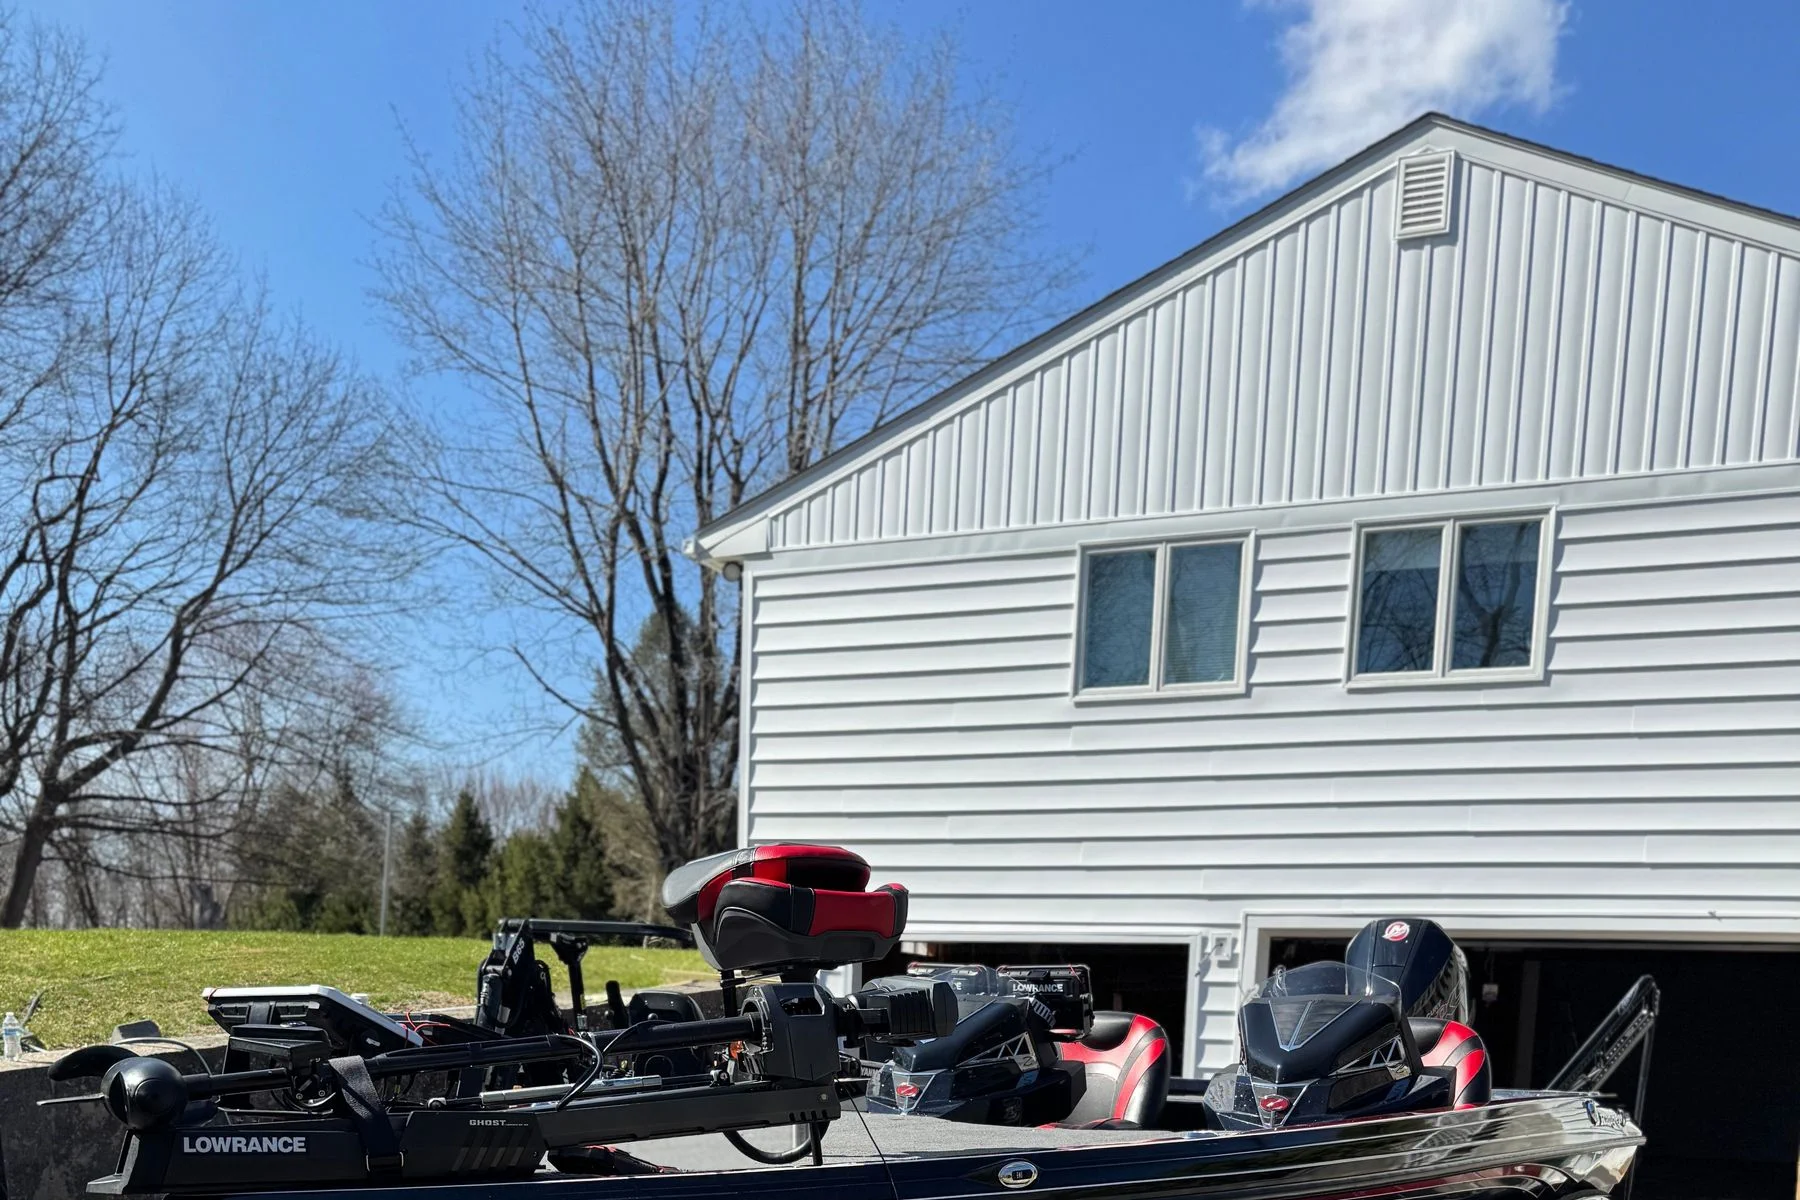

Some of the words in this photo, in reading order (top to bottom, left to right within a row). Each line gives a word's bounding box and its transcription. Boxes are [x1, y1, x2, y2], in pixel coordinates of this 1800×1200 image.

[1012, 983, 1064, 993] LOWRANCE
[469, 1119, 507, 1127] GHOST
[183, 1136, 307, 1153] LOWRANCE
